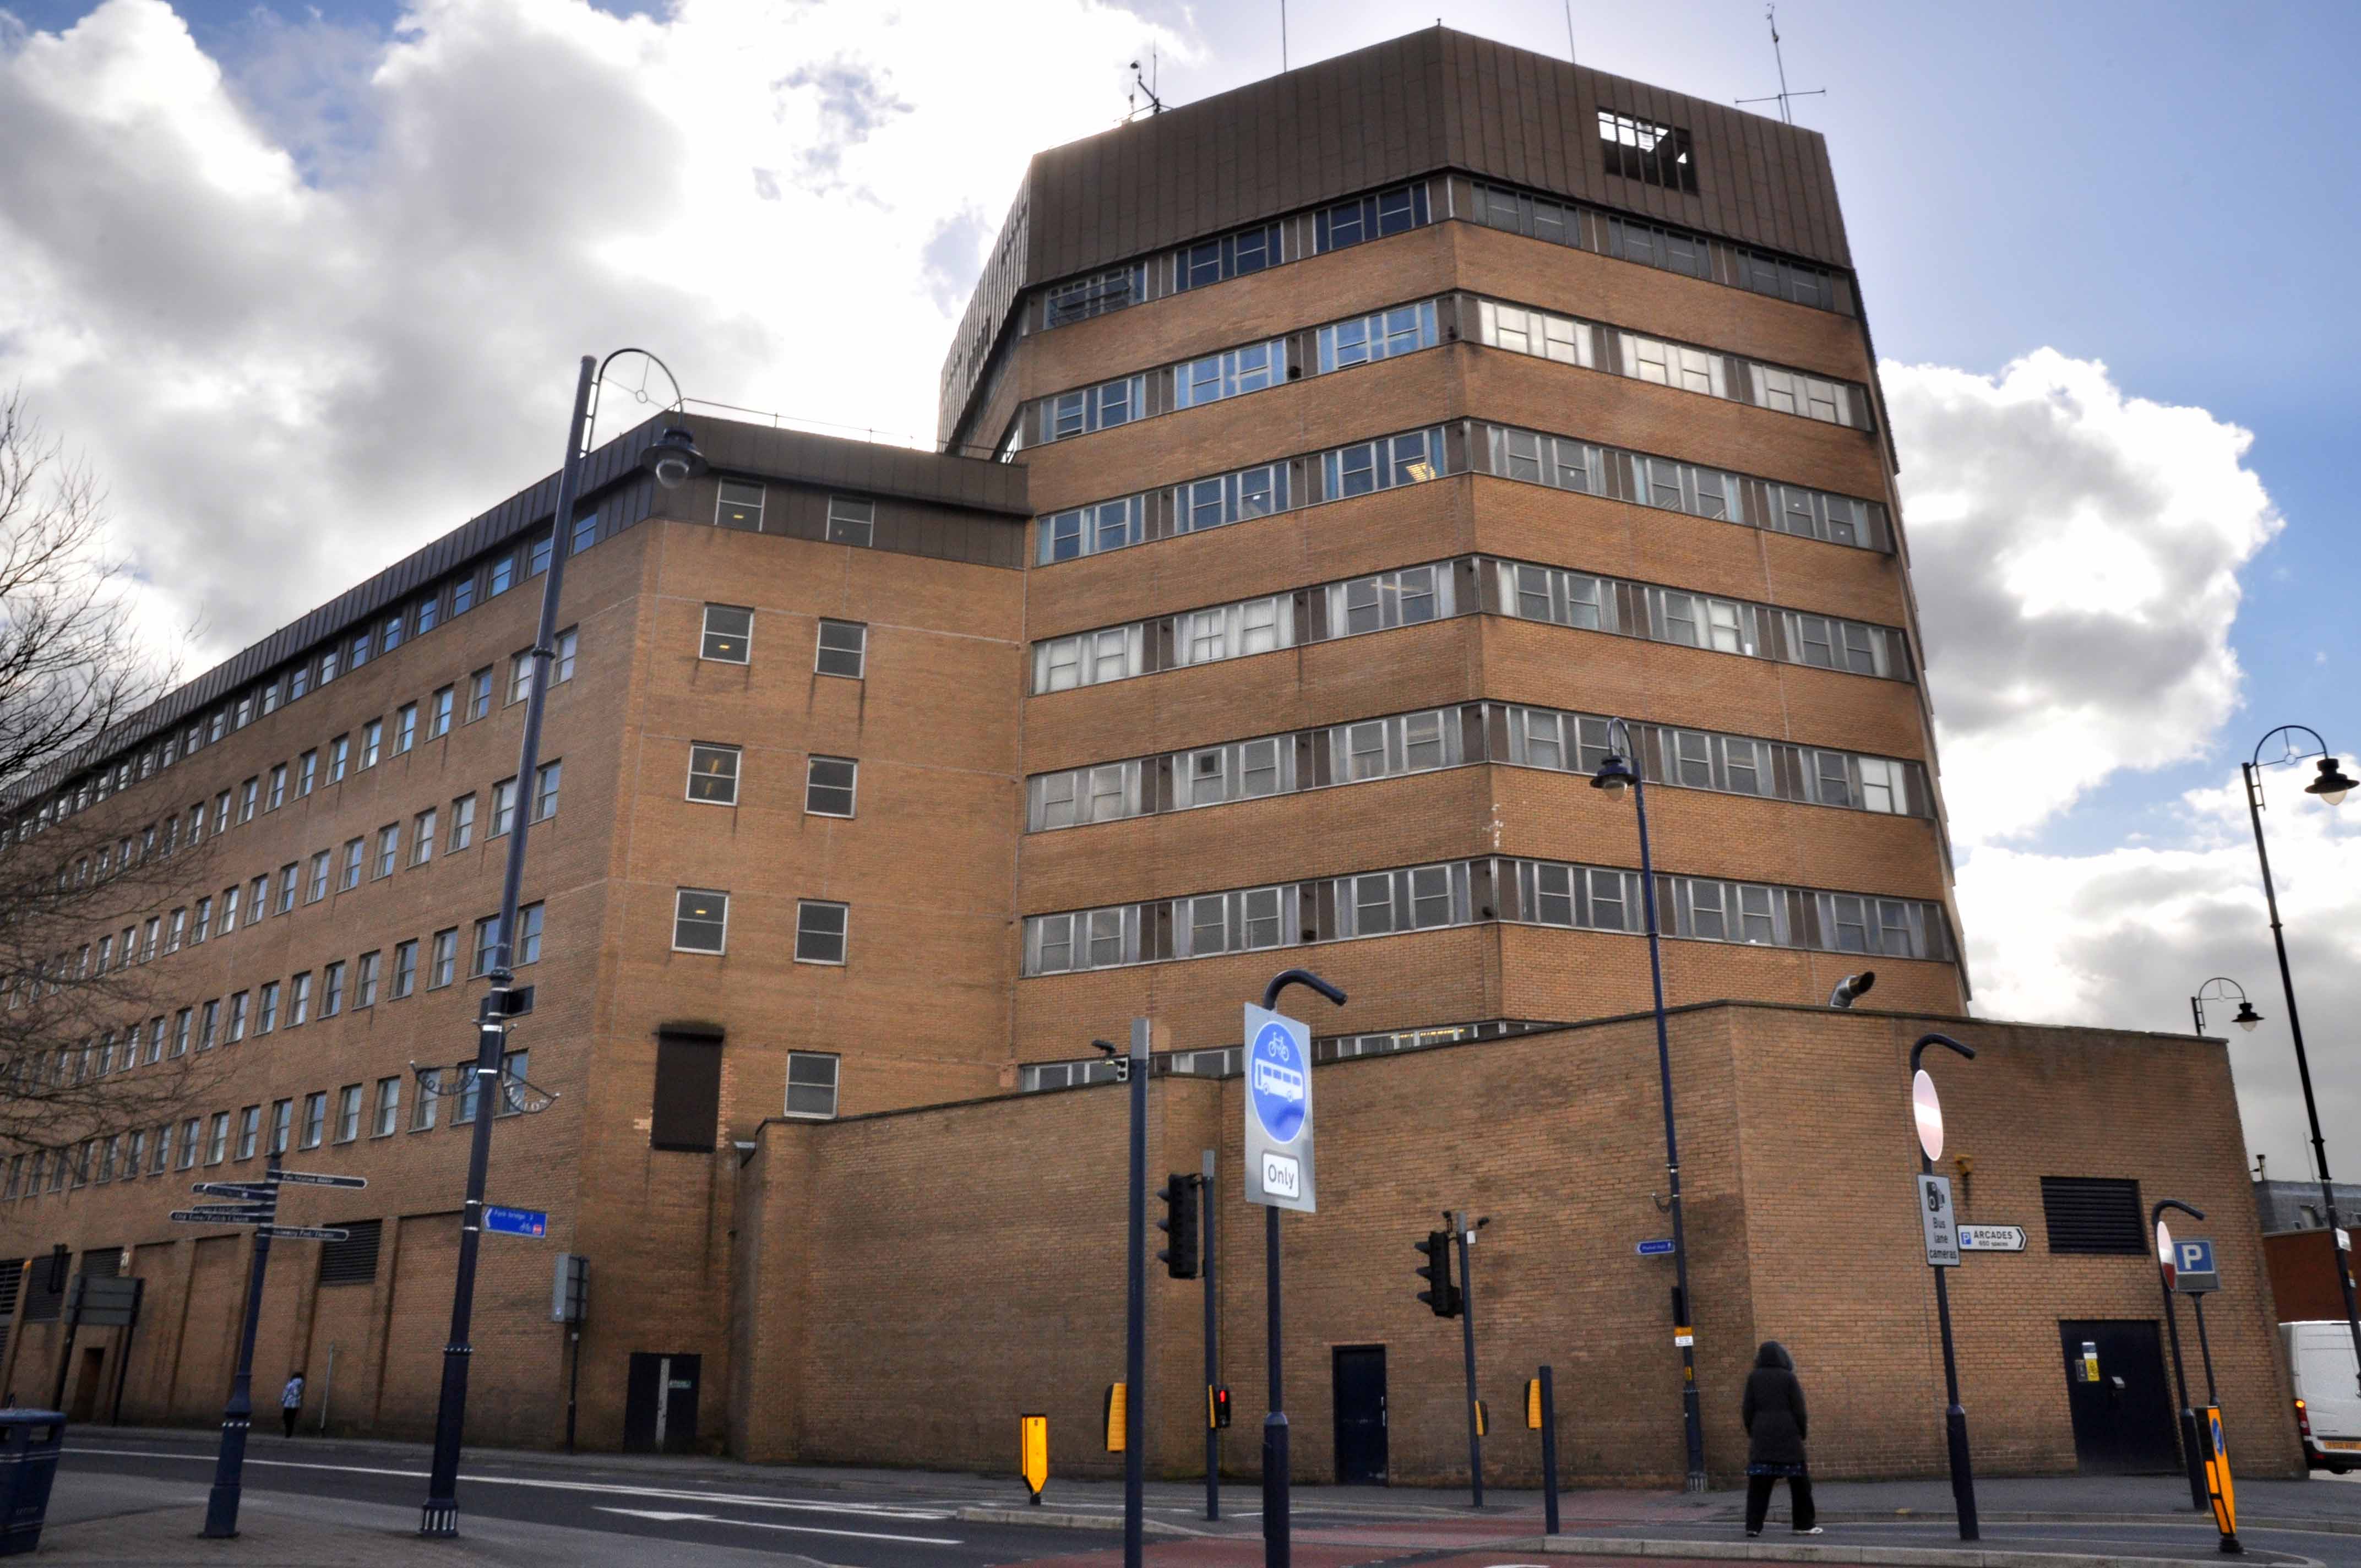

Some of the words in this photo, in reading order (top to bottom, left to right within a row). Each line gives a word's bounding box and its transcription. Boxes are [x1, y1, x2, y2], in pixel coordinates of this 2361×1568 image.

[1268, 1164, 1294, 1190] Only
[1933, 1217, 1946, 1228] Bus
[1934, 1232, 1948, 1243] lane
[1974, 1231, 2012, 1239] ARCADES
[1929, 1249, 1957, 1259] cameras
[2182, 1245, 2202, 1269] P
